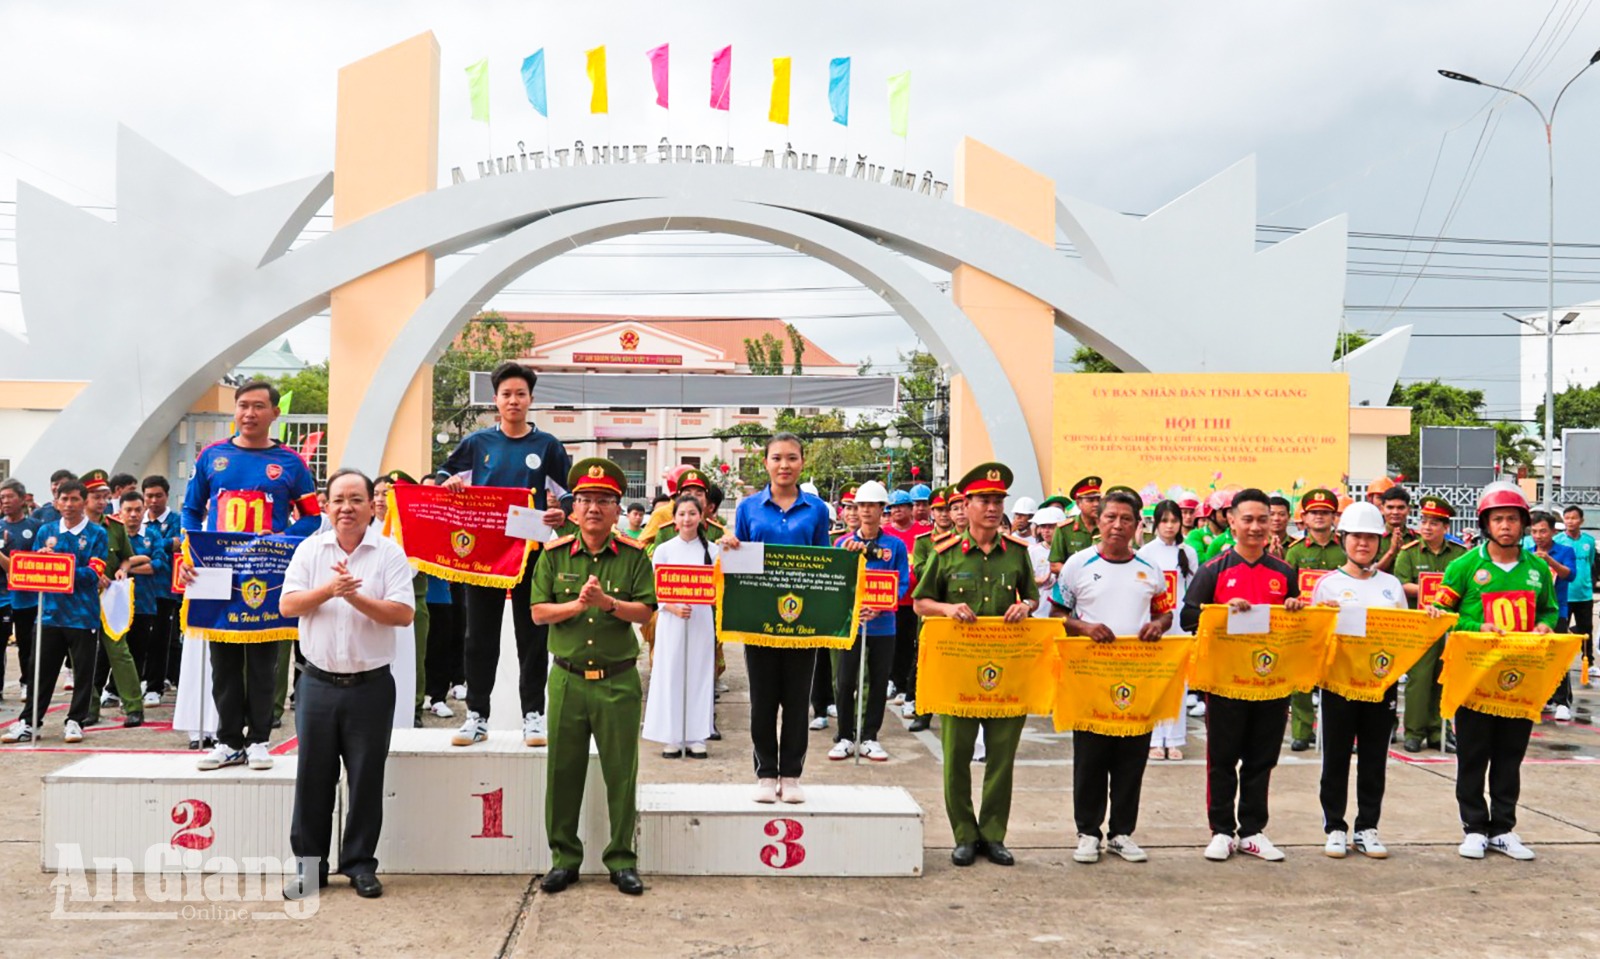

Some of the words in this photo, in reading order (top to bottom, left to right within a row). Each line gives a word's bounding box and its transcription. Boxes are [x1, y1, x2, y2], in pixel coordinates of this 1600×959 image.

[1112, 388, 1137, 398] BAN
[1141, 387, 1177, 398] NHÂN
[1180, 387, 1206, 398] DÂN
[1211, 387, 1241, 398] TỈNH
[1245, 388, 1261, 398] AN
[1264, 388, 1308, 398] GIANG
[1165, 417, 1197, 432] HỘI
[1202, 418, 1231, 429] THI
[1121, 434, 1157, 444] NGHIỆP
[1160, 444, 1185, 452] TOÀN
[1179, 454, 1212, 462] GIANG
[1214, 454, 1236, 462] NĂM
[225, 497, 264, 533] 01
[258, 547, 287, 556] GIANG
[766, 552, 785, 560] BAN
[786, 553, 812, 562] NHÂN
[813, 554, 832, 563] DÂN
[796, 562, 824, 570] GIANG
[691, 574, 699, 583] AN
[1492, 597, 1528, 631] 01
[471, 787, 513, 838] 1
[170, 798, 215, 850] 2
[760, 818, 806, 869] 3
